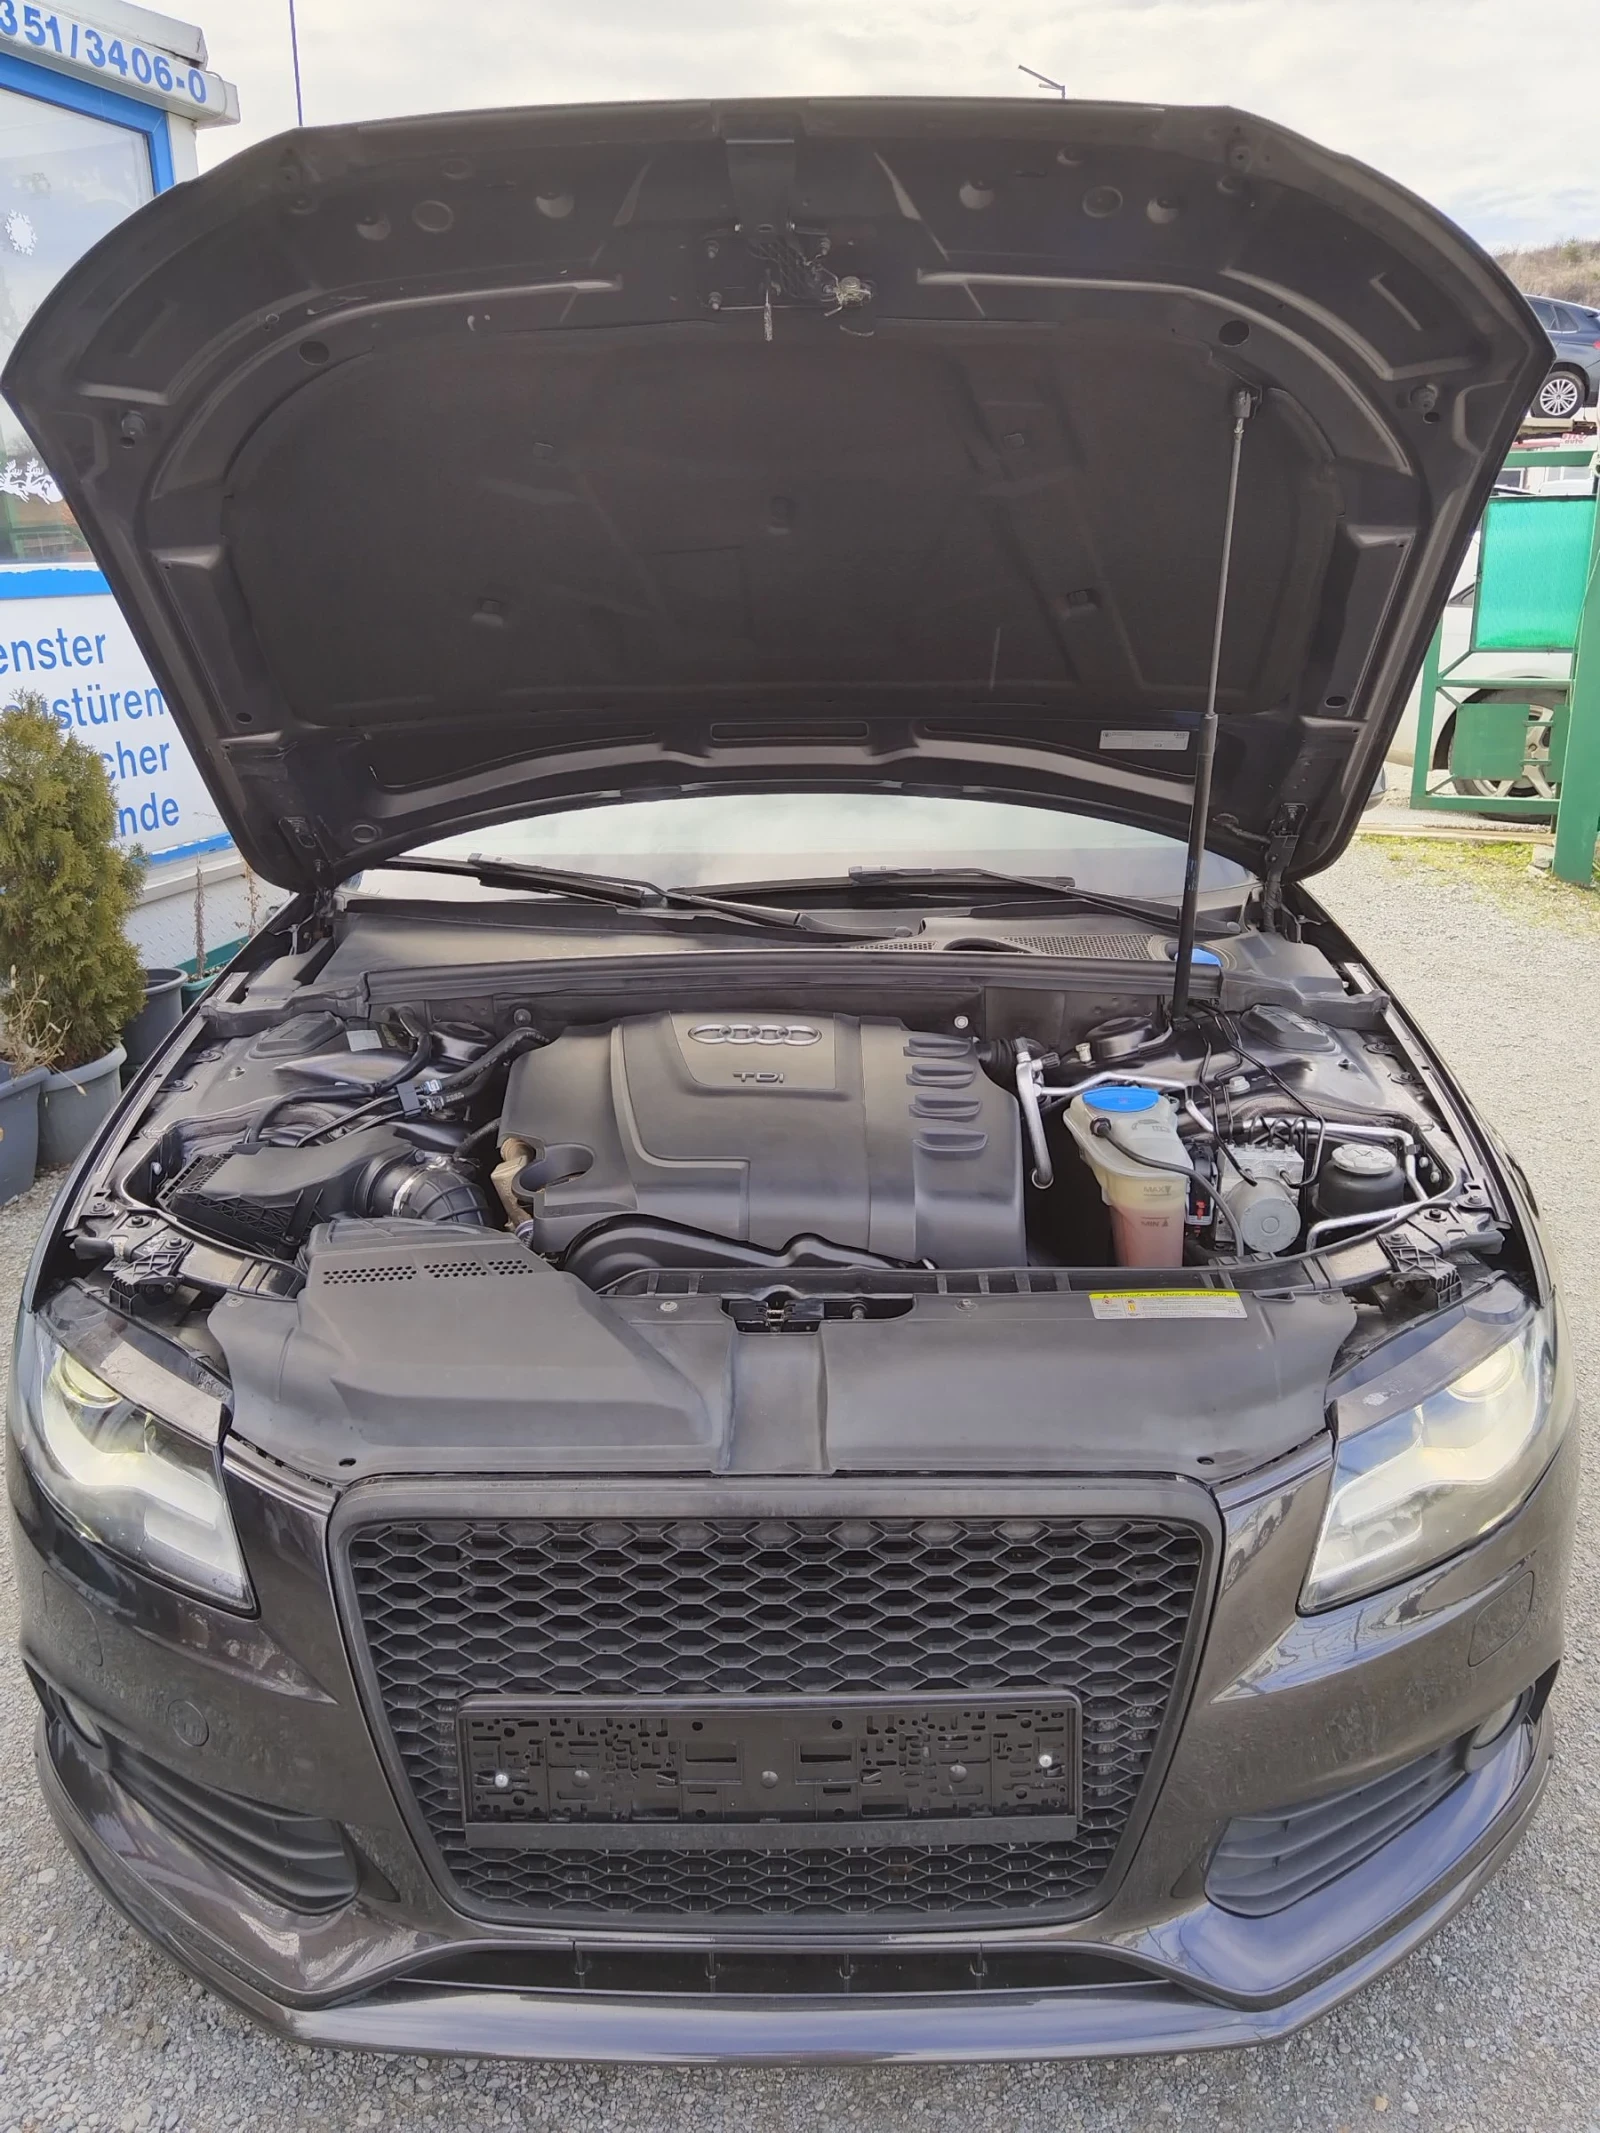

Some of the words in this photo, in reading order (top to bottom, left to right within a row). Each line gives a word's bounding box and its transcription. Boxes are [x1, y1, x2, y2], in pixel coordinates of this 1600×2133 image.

[0, 0, 207, 103] 351/3406-0
[3, 684, 164, 730] stüren
[733, 1071, 784, 1083] TDI
